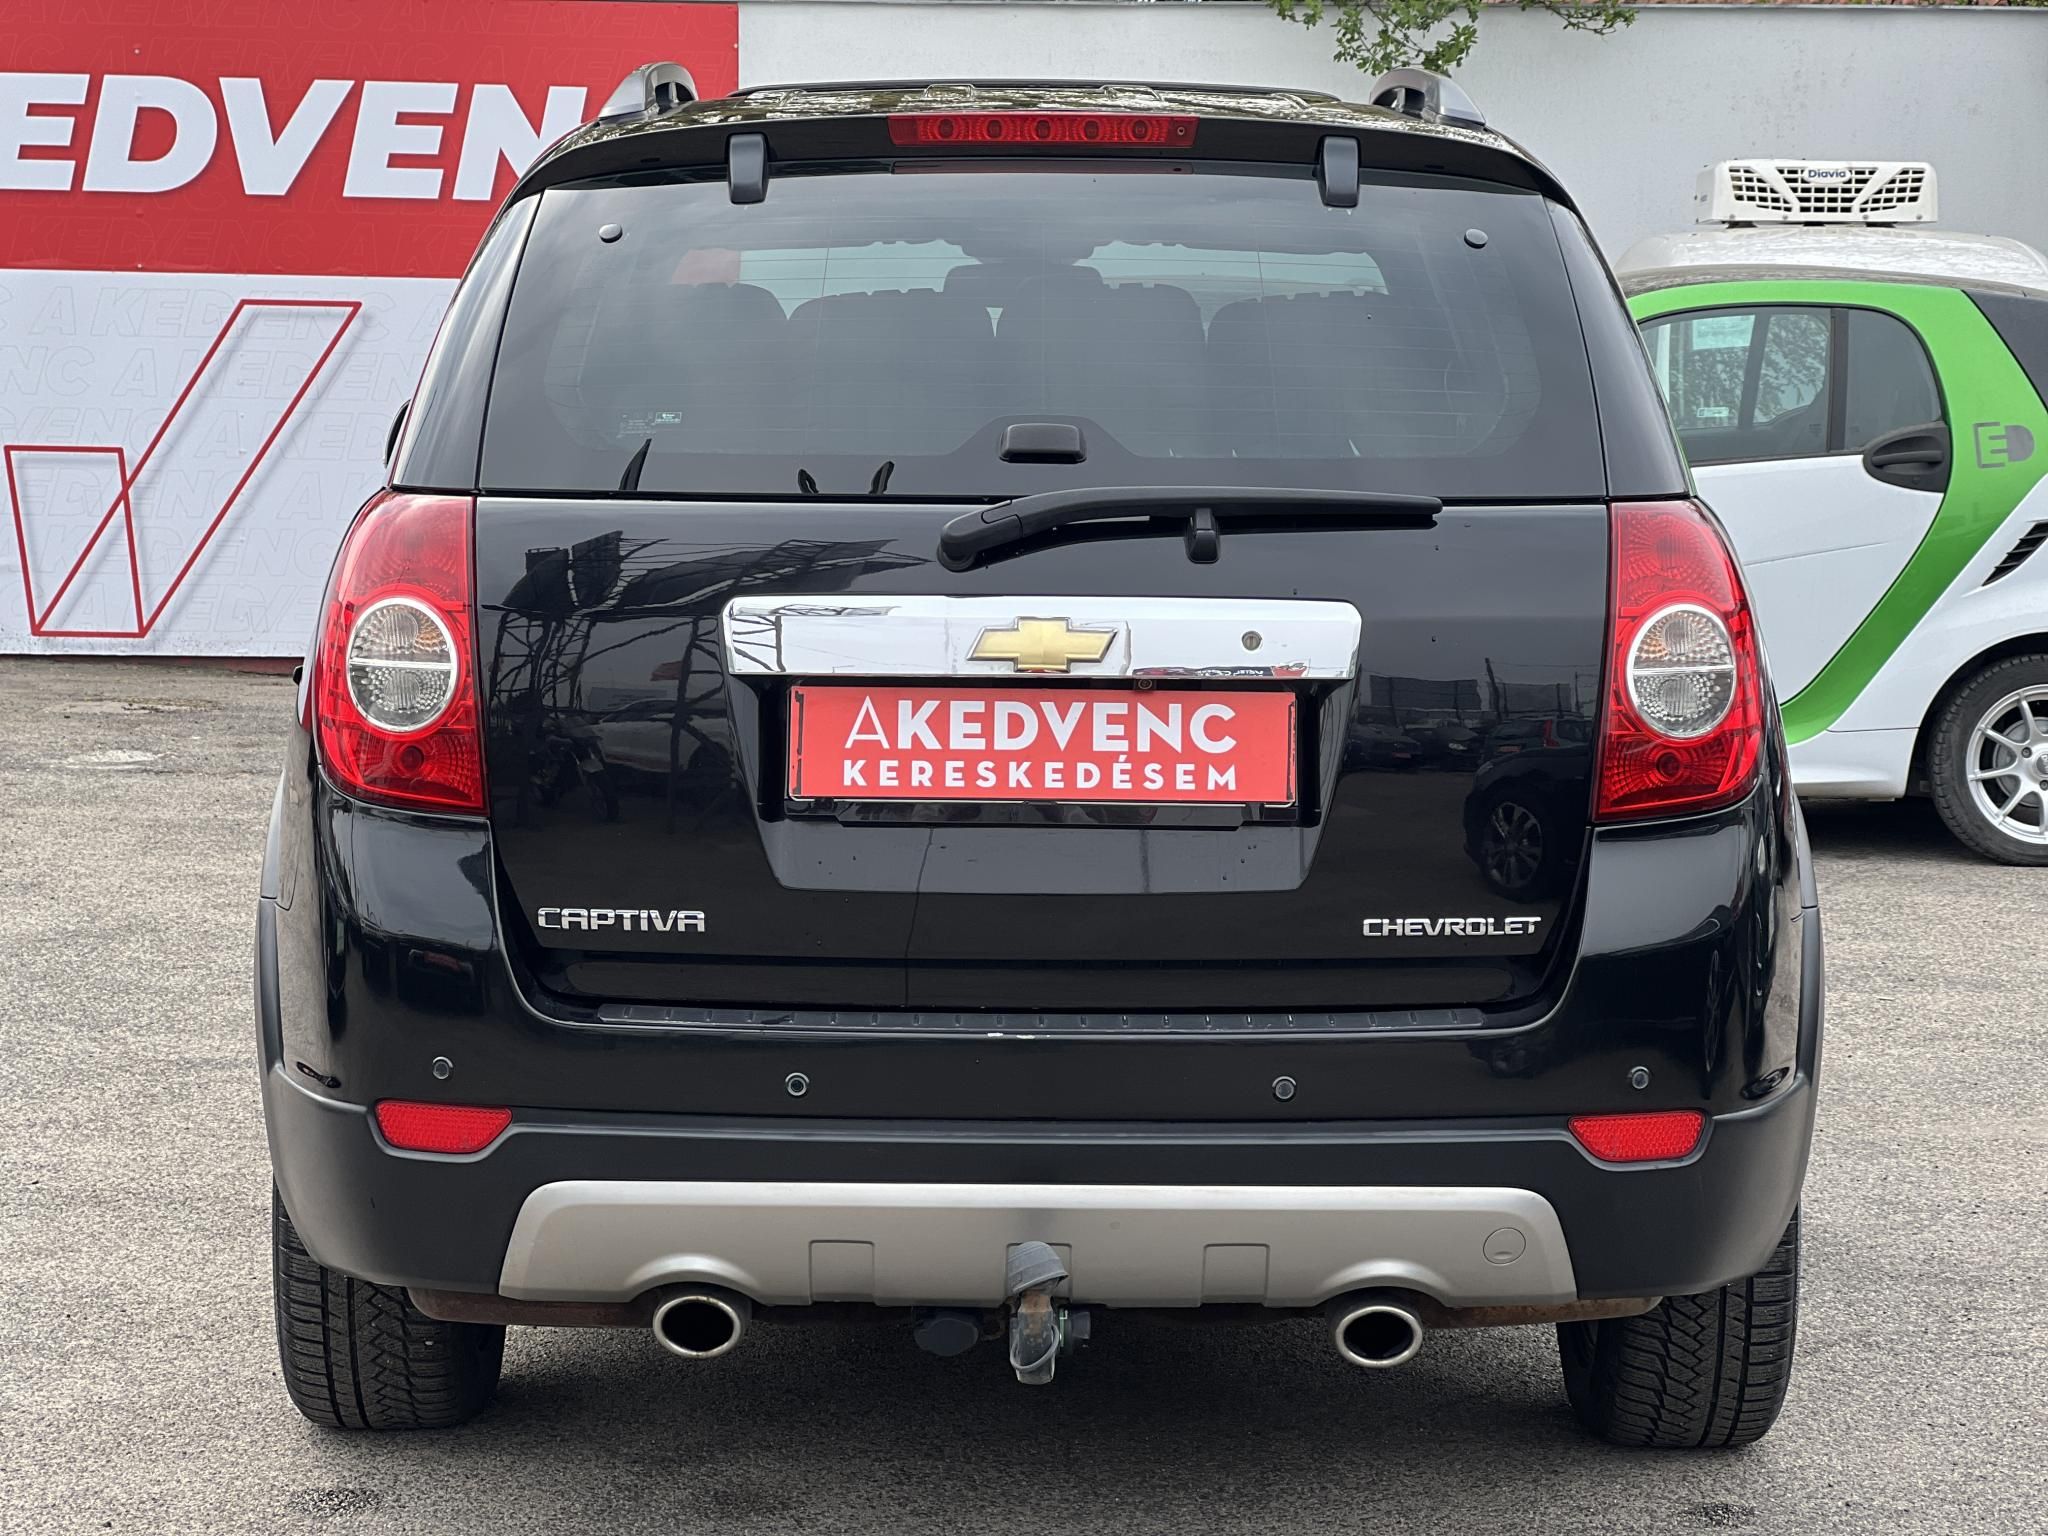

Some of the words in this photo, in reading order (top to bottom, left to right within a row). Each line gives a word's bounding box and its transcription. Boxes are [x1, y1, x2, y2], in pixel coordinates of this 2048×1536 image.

[1807, 169, 1847, 178] Diavia
[843, 754, 1237, 791] KERESKEDÉSEM
[538, 907, 705, 932] CAPTIVA
[1363, 916, 1542, 936] CHEVROLET
